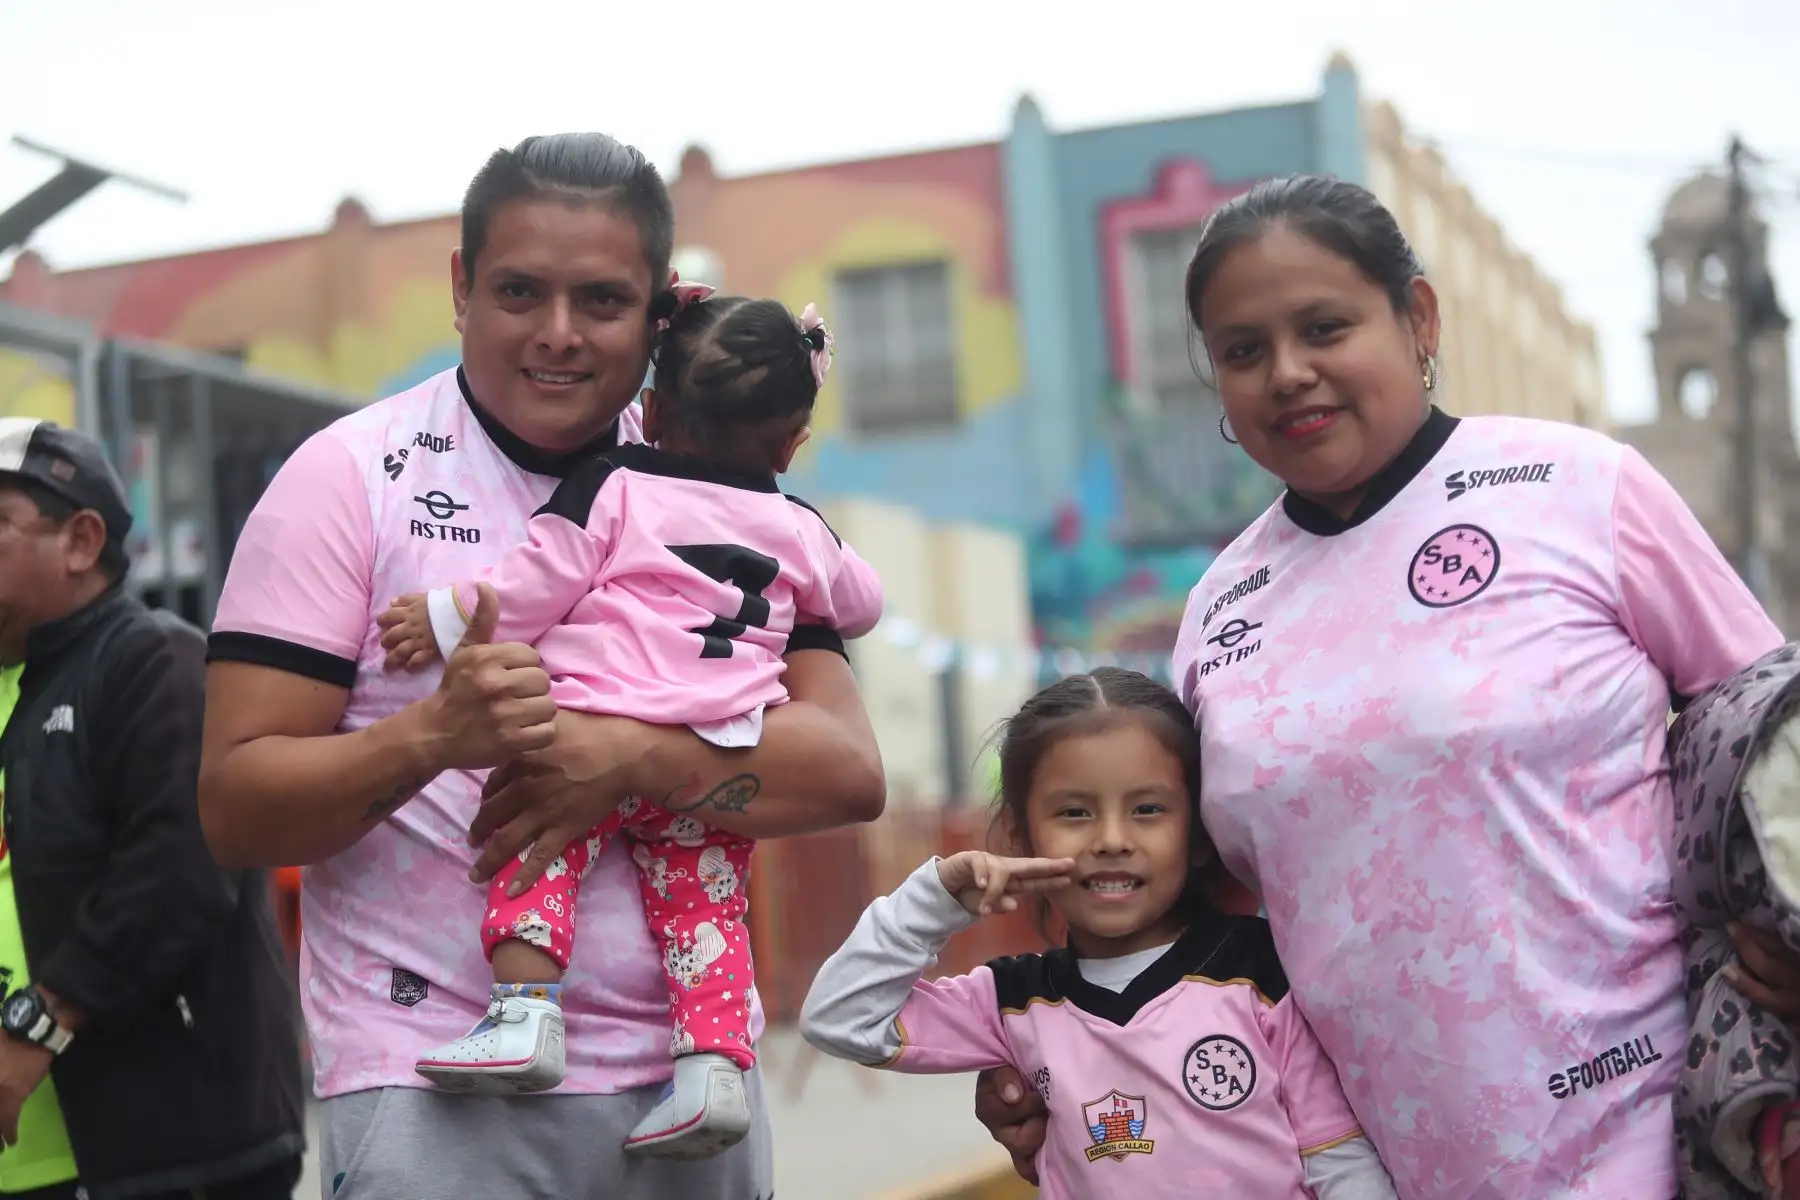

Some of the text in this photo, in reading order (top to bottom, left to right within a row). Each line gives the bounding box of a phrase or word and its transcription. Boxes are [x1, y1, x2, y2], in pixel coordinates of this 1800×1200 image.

[398, 432, 455, 464] SRADE
[1467, 463, 1554, 489] SPORADE
[410, 519, 481, 544] ASTRO
[1195, 1049, 1244, 1096] SBA
[1089, 1142, 1150, 1157] REGION CALLAO
